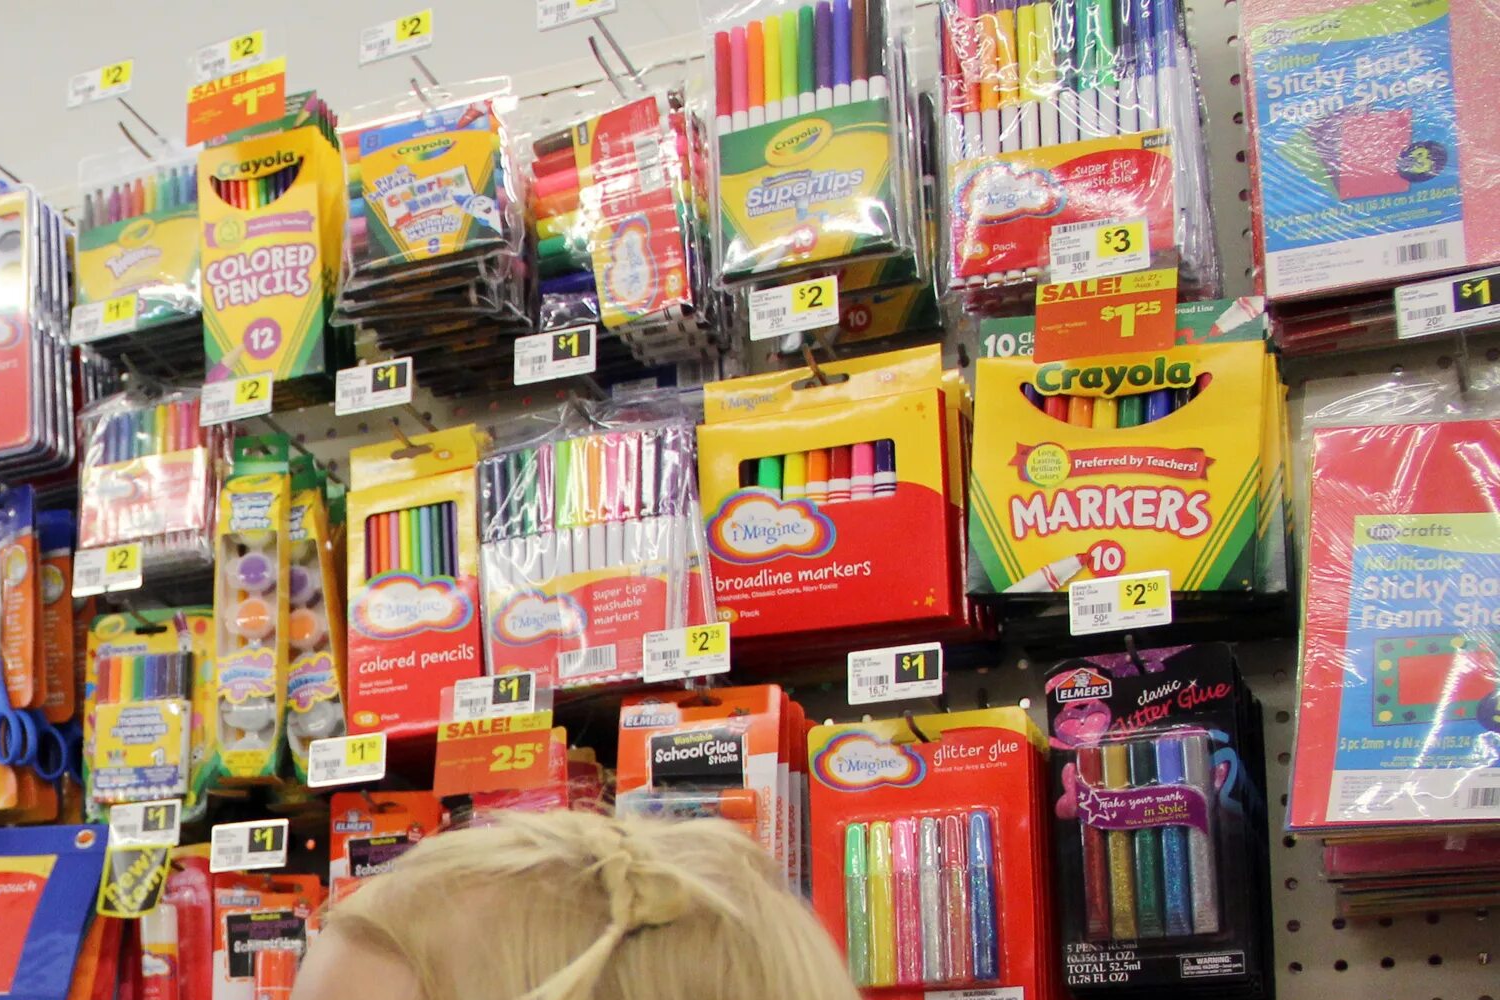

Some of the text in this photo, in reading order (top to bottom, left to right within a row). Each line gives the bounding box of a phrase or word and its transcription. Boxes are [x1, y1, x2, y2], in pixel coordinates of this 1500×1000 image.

[401, 18, 421, 35] $2
[235, 37, 254, 56] $2
[1265, 52, 1319, 72] Glitter
[1267, 46, 1425, 98] Sticky Back
[192, 71, 247, 99] SALE!
[1268, 69, 1449, 122] Foam Sheets
[397, 138, 451, 155] Crayola
[774, 125, 822, 151] Crayola
[217, 150, 295, 179] Crayola
[1075, 158, 1132, 177] super tip
[1412, 147, 1432, 174] 3
[748, 170, 864, 208] SuperTips
[993, 242, 1017, 253] Pack
[1104, 229, 1131, 253] $3
[206, 245, 315, 285] COLORED
[212, 269, 311, 311] PENCILS
[799, 285, 824, 309] $2
[1041, 276, 1122, 302] SALE!
[1462, 279, 1491, 305] $1
[1197, 304, 1214, 313] Line
[250, 327, 275, 350] 12
[558, 334, 579, 358] $1
[984, 333, 1016, 358] 10
[377, 366, 397, 389] $1
[1036, 357, 1192, 395] Crayola
[241, 381, 260, 400] $2
[1075, 455, 1198, 472] Preferred by Teachers!
[1011, 487, 1210, 538] MARKERS
[1091, 547, 1120, 571] 10
[1364, 554, 1465, 572] Multicolor
[716, 560, 872, 592] broadline markers
[593, 583, 648, 602] Super tips
[1363, 574, 1448, 603] Sticky
[593, 597, 643, 613] washable
[740, 609, 760, 619] Pack
[1361, 605, 1442, 629] Foam
[594, 610, 640, 626] markers
[359, 643, 475, 674] colored pencils
[902, 653, 925, 680] $1
[499, 678, 520, 701] $1
[1060, 679, 1182, 706] ELMER'S classic
[1178, 681, 1232, 710] Glue
[445, 716, 512, 738] SALE!
[625, 713, 676, 727] ELMER'S
[673, 732, 714, 746] Washable
[489, 743, 544, 773] 25¢
[655, 740, 738, 764] School Glue
[708, 753, 739, 766] Sticks
[933, 739, 1019, 767] glitter glue
[1144, 802, 1188, 817] in Style!
[254, 828, 275, 850] $1
[1067, 961, 1142, 975] TOTAL 52.5ml
[1115, 951, 1135, 962] OZ)
[1067, 972, 1130, 985] (1.78 FL OZ)
